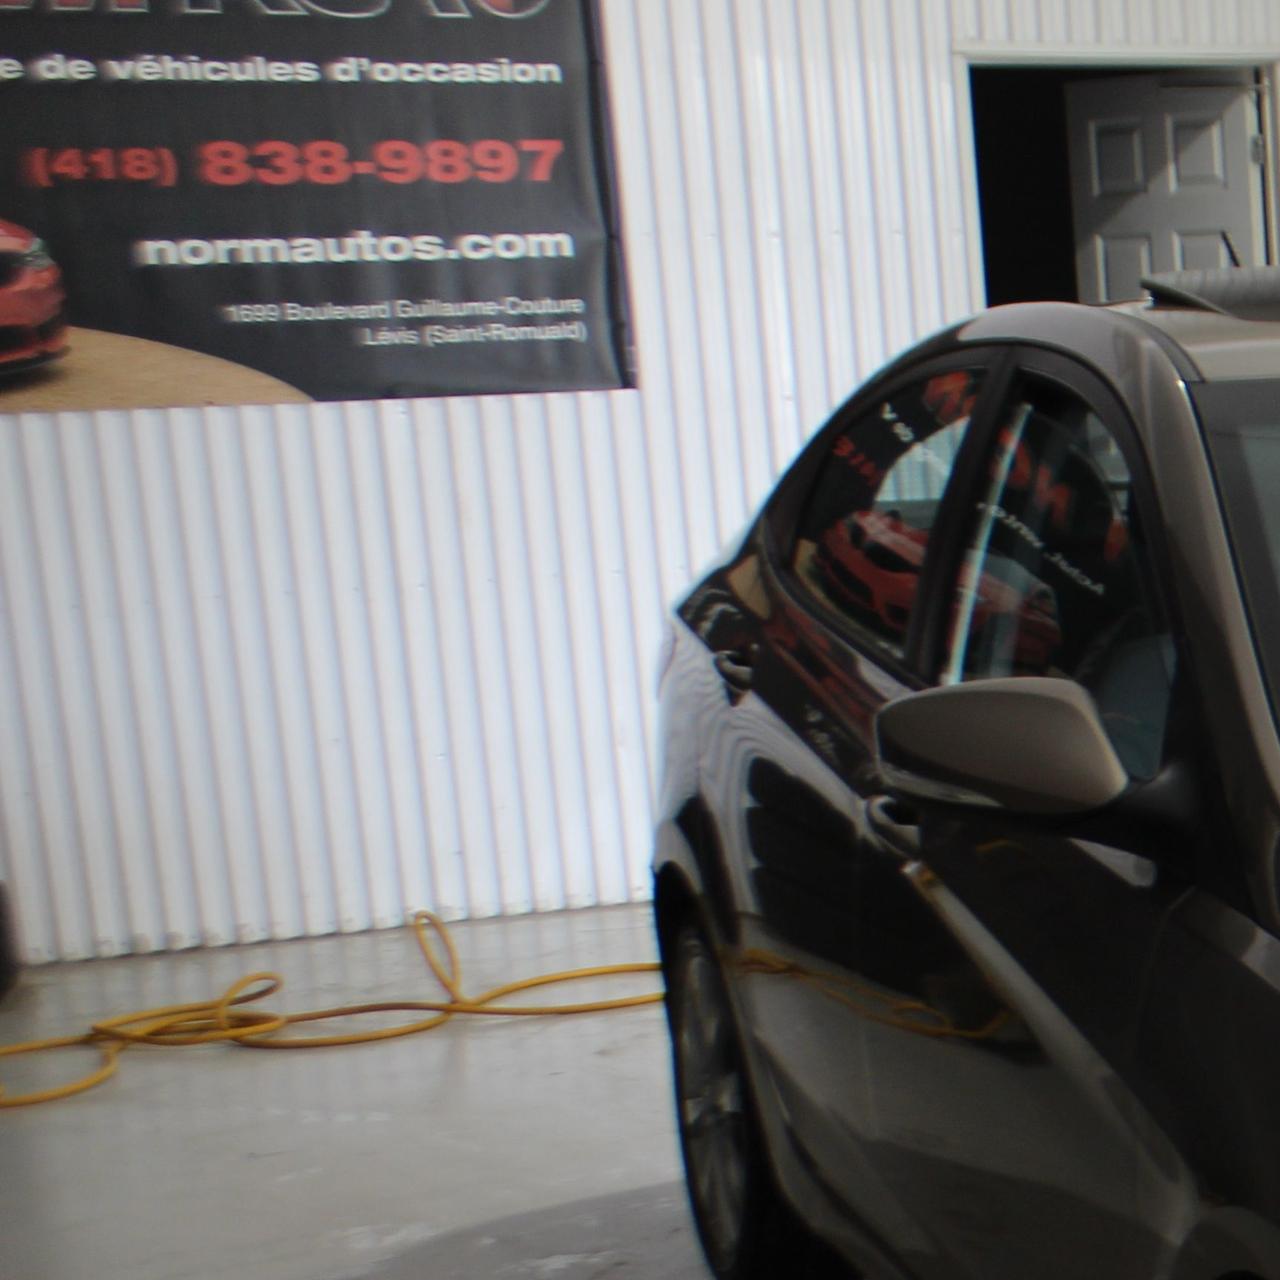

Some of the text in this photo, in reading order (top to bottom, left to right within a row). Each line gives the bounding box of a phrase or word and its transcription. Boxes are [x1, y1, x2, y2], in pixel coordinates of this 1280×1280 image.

[36, 53, 97, 81] de
[105, 54, 320, 82] véhicules
[329, 57, 563, 83] d'occasion
[29, 139, 564, 187] (418) 838-9897
[138, 229, 576, 266] normautos.com
[283, 301, 391, 321] Boulevard
